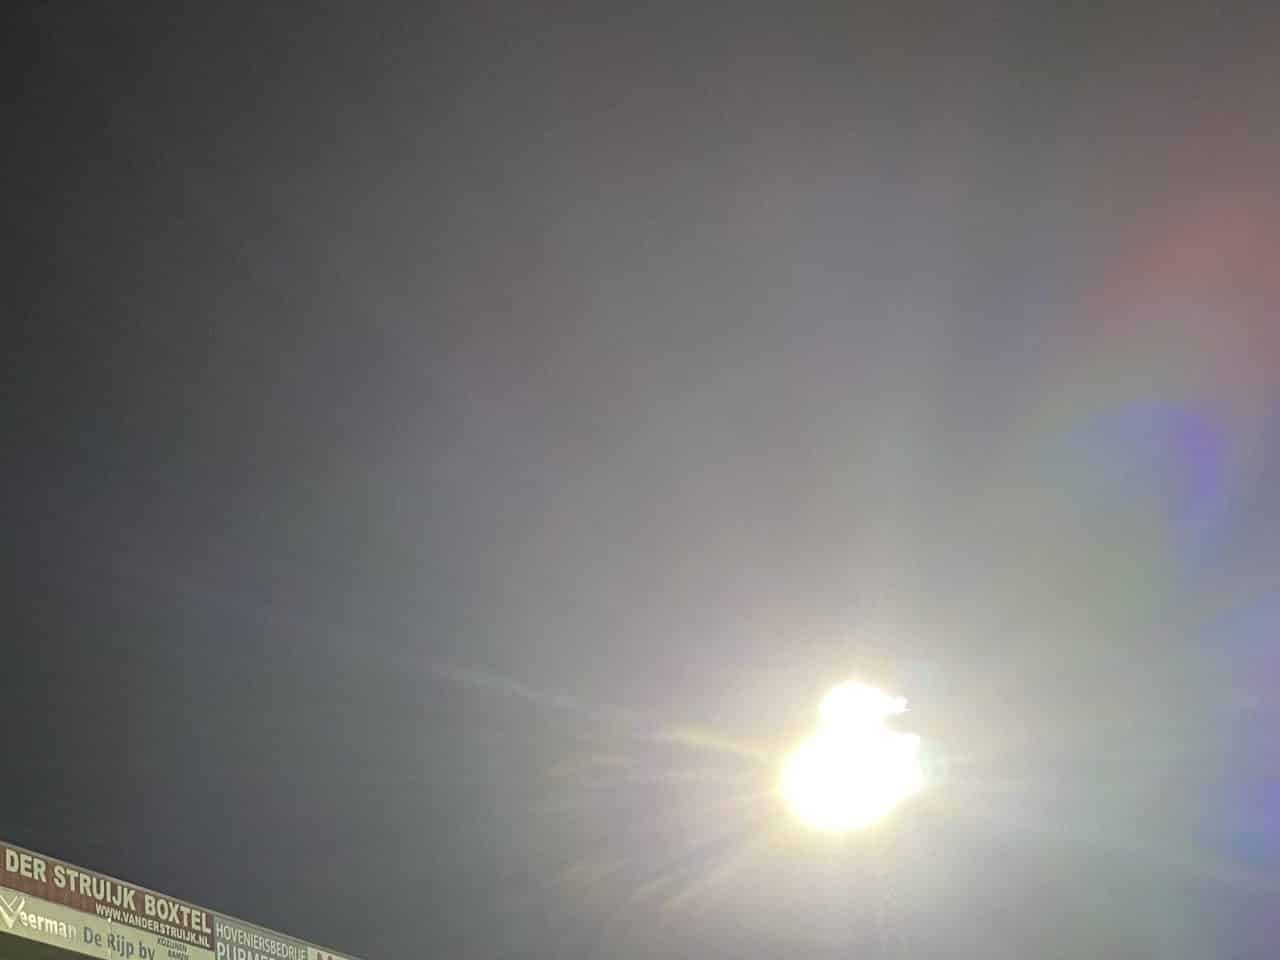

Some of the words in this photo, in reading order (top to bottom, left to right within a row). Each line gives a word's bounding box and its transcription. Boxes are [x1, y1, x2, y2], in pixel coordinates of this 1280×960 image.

[5, 848, 47, 882] DER
[53, 865, 136, 912] STRUIJK
[144, 896, 212, 934] BOXTEL
[83, 925, 103, 947] De
[107, 933, 135, 960] Rijp
[95, 903, 210, 948] WWW.VANDERSTRUIJK.NL
